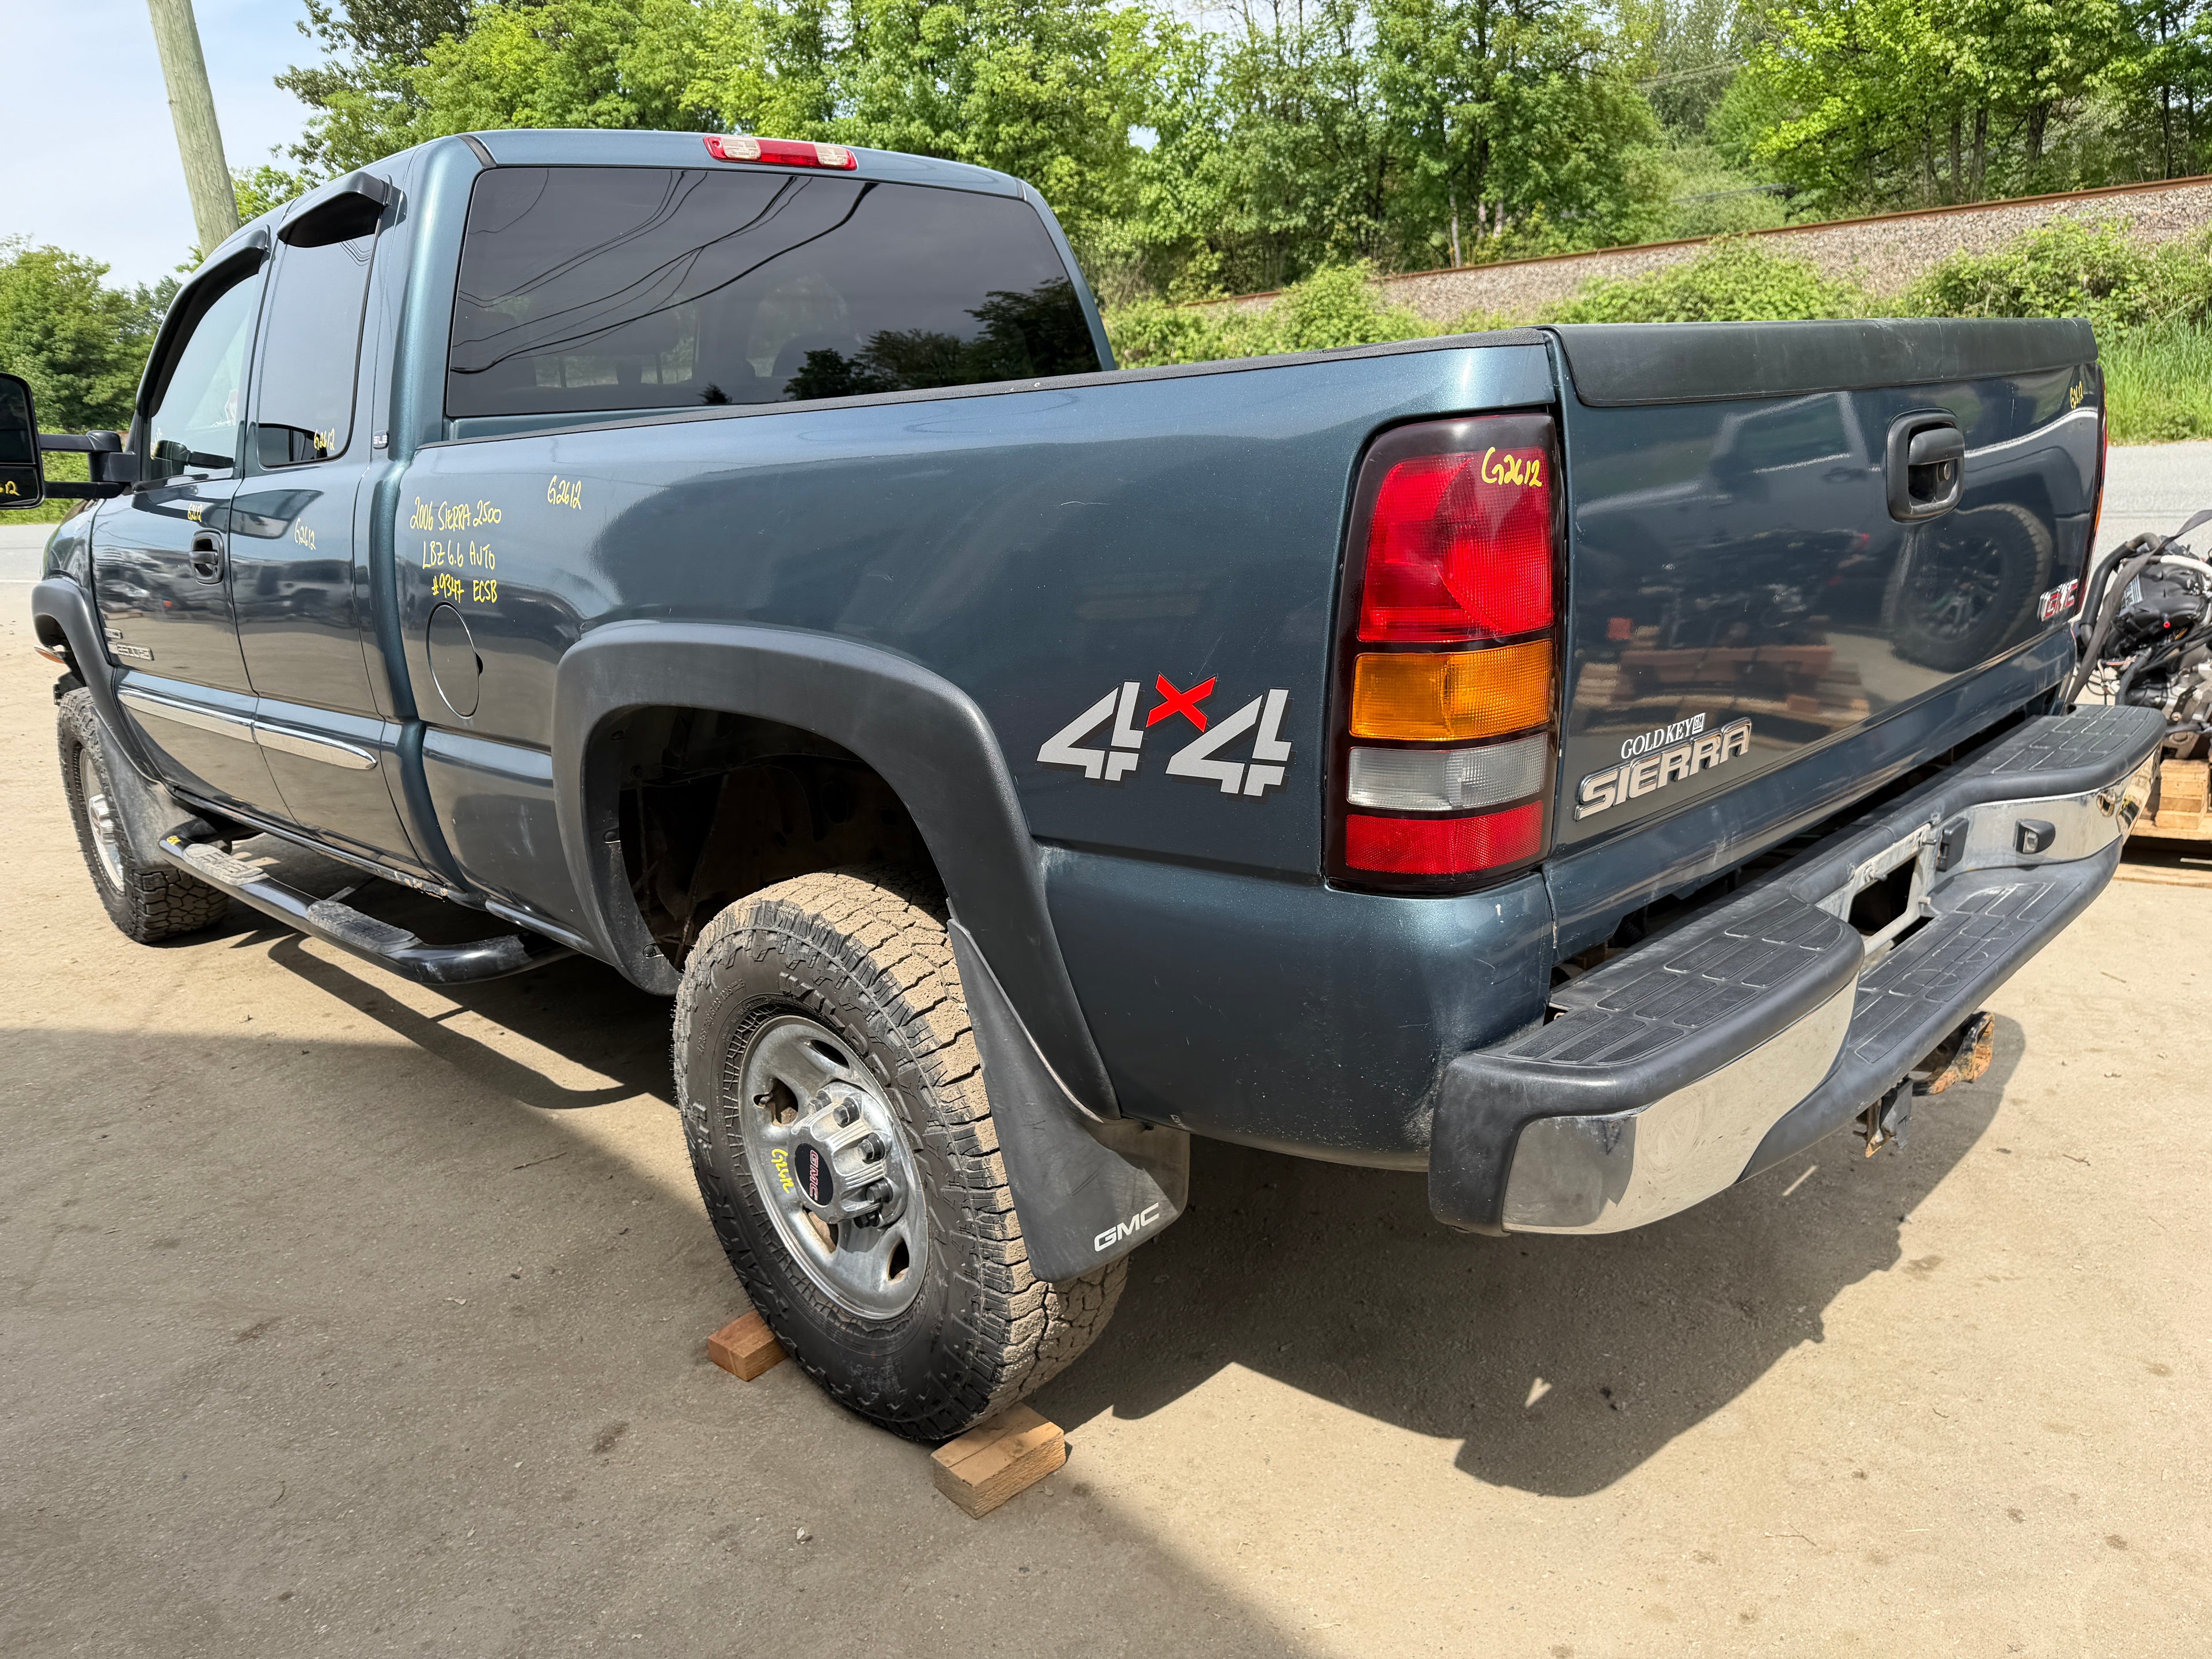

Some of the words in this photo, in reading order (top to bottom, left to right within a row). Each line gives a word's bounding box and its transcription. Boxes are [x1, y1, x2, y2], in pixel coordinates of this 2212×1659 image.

[1481, 446, 1543, 487] G2612
[547, 475, 582, 510] G2612
[410, 496, 433, 531] 2006
[438, 501, 471, 532] SIERRA
[472, 499, 502, 527] 2500
[422, 540, 446, 570] LBZ
[447, 539, 464, 567] 6.6
[431, 573, 465, 604] #9347
[473, 579, 498, 604] ECSB
[1574, 717, 1752, 821] SIERRA
[809, 1149, 819, 1201] GMC
[1094, 1202, 1160, 1252] GMC
